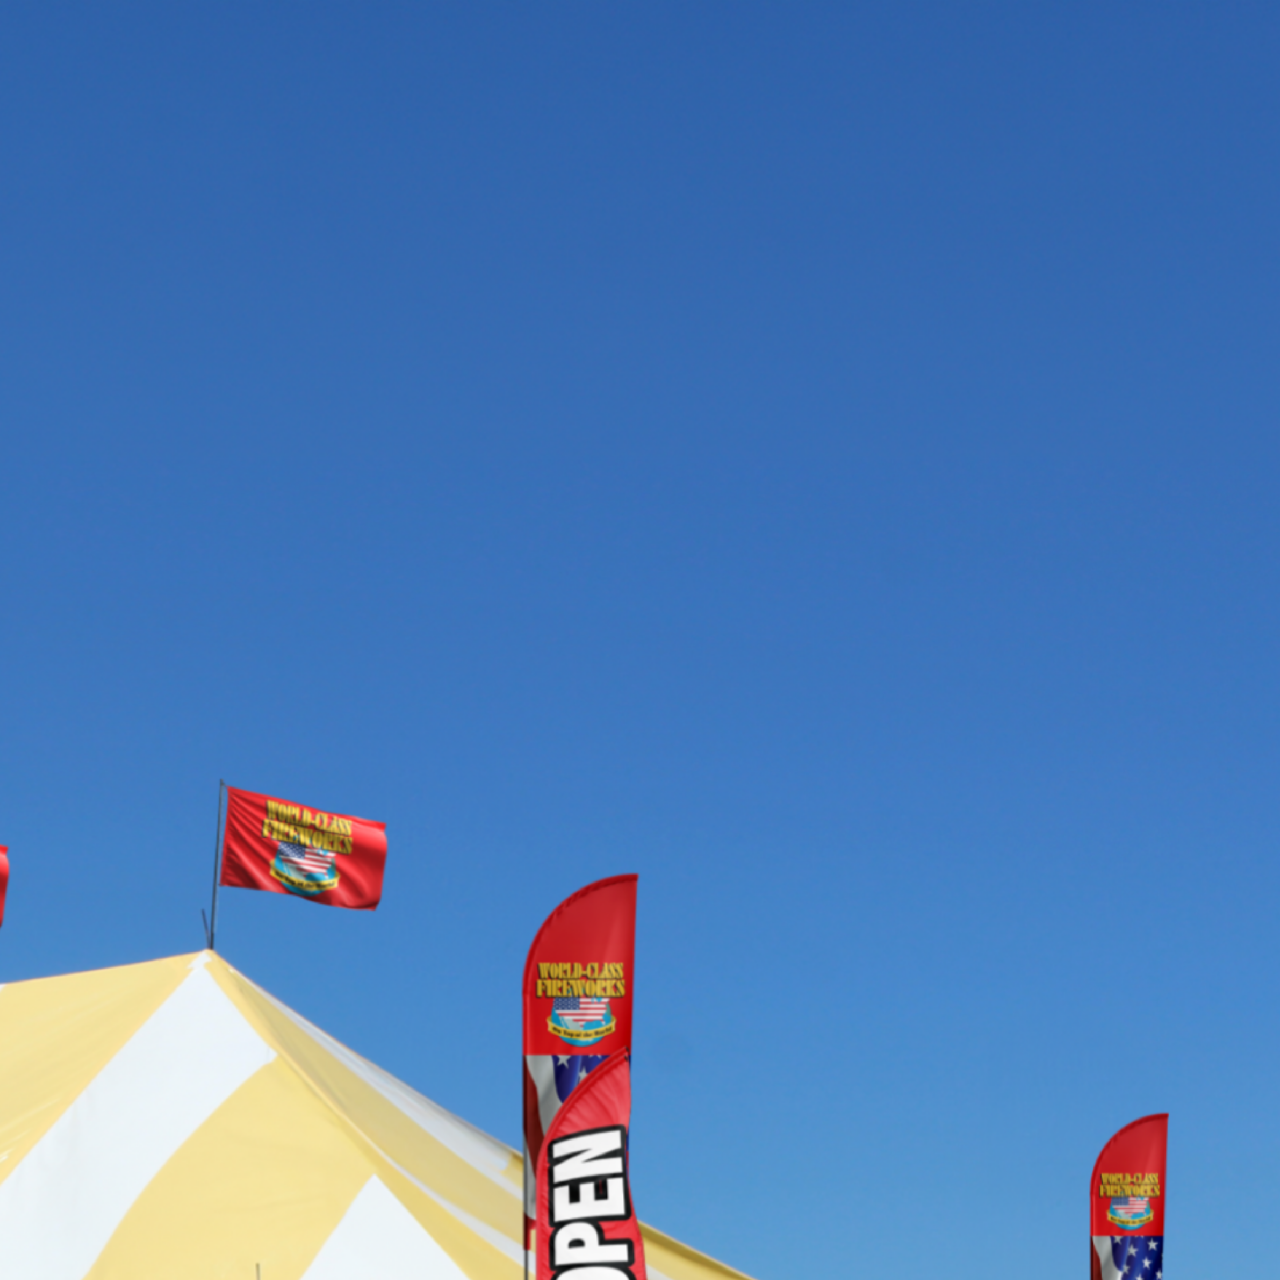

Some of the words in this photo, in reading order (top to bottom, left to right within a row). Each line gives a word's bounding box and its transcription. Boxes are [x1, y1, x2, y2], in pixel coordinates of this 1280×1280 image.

[261, 818, 353, 855] FIREWORKS
[537, 962, 624, 979] WORLD-CLASS
[536, 979, 626, 998] FIREWORKS
